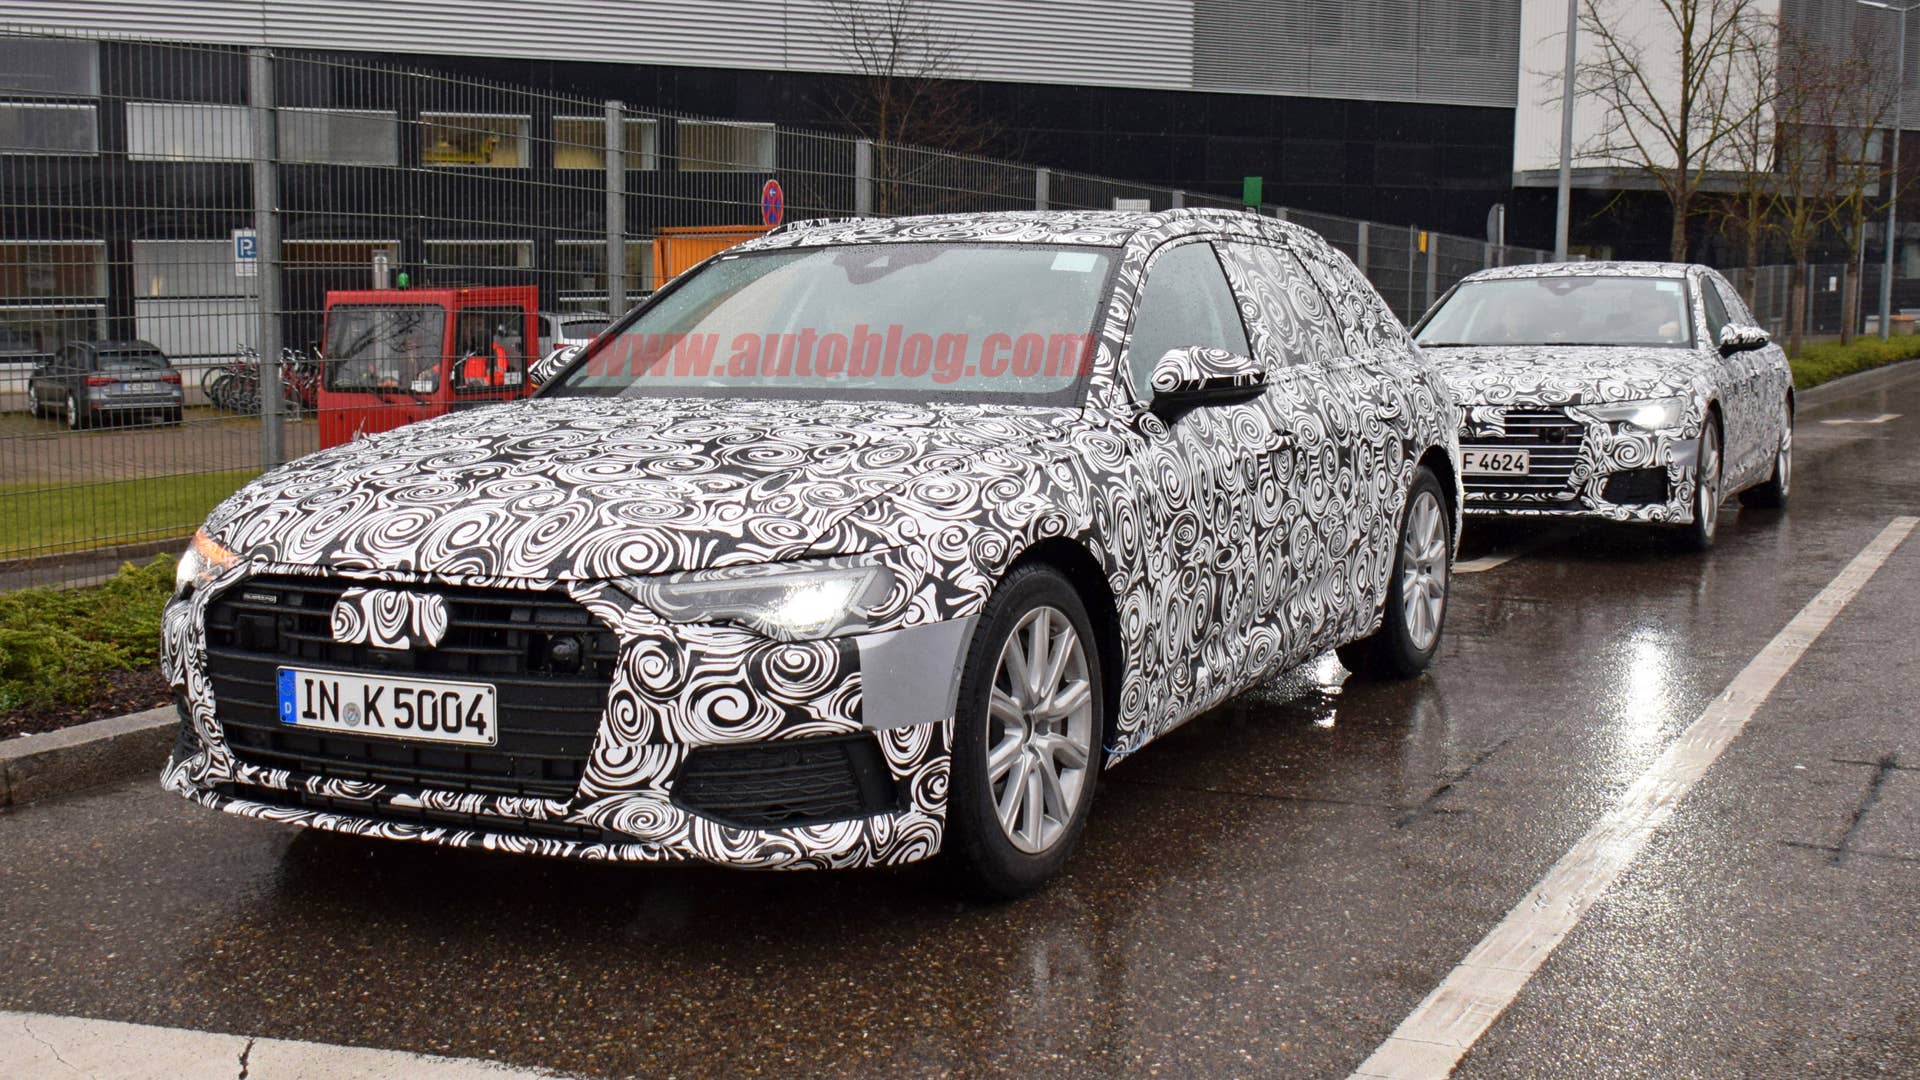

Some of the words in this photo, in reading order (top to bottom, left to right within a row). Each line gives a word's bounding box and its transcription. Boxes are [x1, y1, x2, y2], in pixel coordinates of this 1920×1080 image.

[240, 239, 253, 256] P
[1479, 454, 1524, 471] 4624
[285, 702, 292, 714] D
[302, 679, 339, 722] IN
[364, 685, 385, 727] K
[394, 687, 487, 735] 5004
